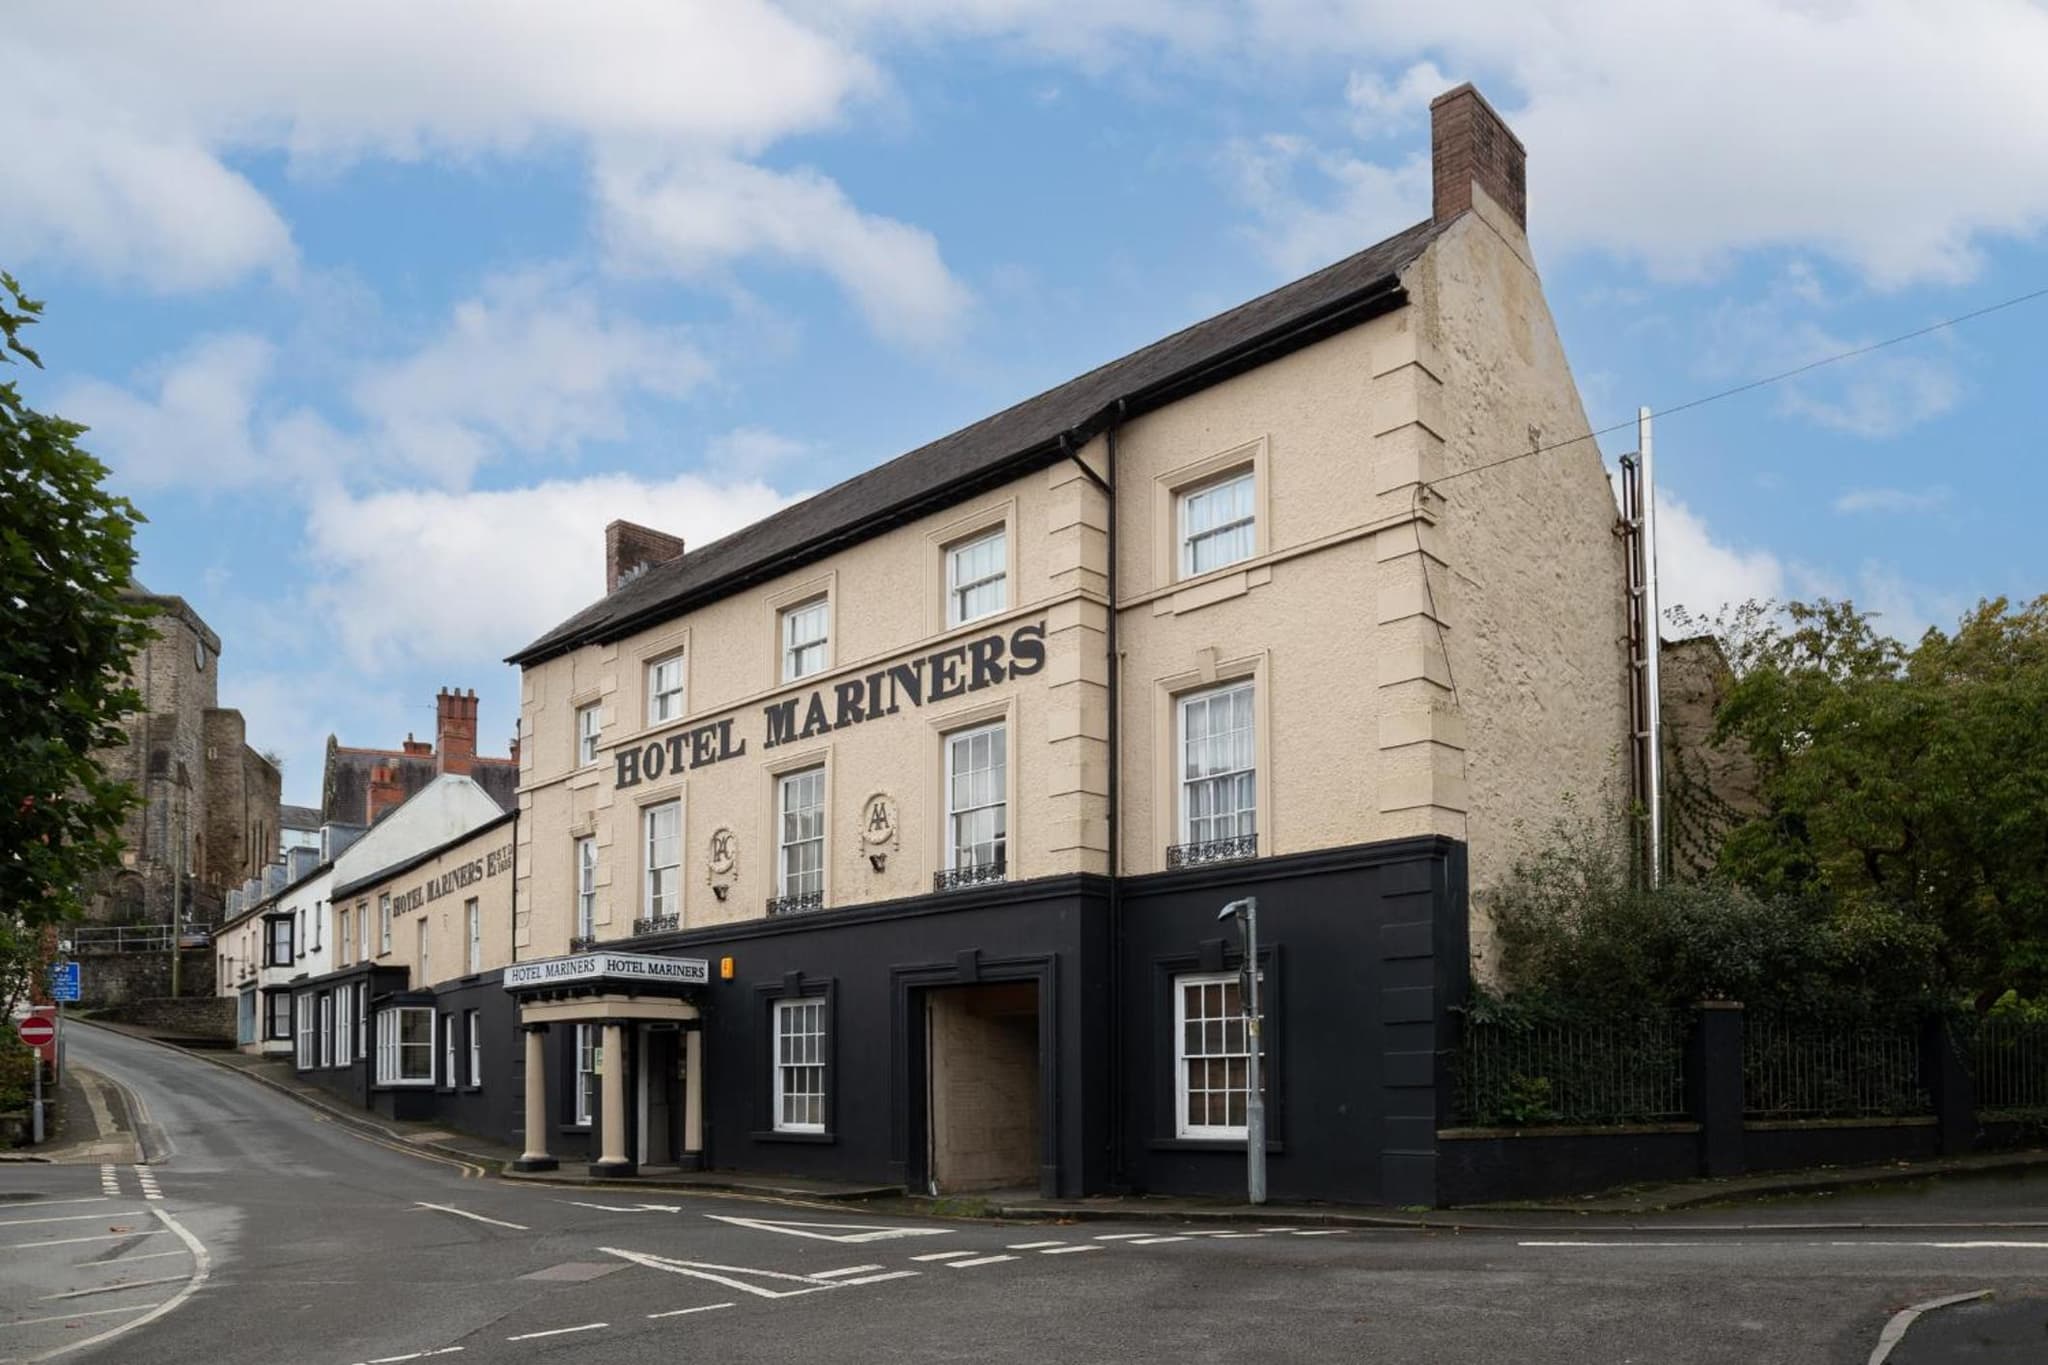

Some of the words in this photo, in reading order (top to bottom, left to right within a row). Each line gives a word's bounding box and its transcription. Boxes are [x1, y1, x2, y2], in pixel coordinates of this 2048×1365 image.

[615, 718, 746, 790] HOTEL
[764, 621, 1046, 749] MARINERS
[393, 886, 424, 917] HOTEL
[426, 858, 483, 903] MARINERS
[511, 968, 542, 982] HOTEL
[545, 958, 595, 977] MARINERS
[607, 959, 646, 974] HOTEL
[648, 963, 705, 979] MARINERS
